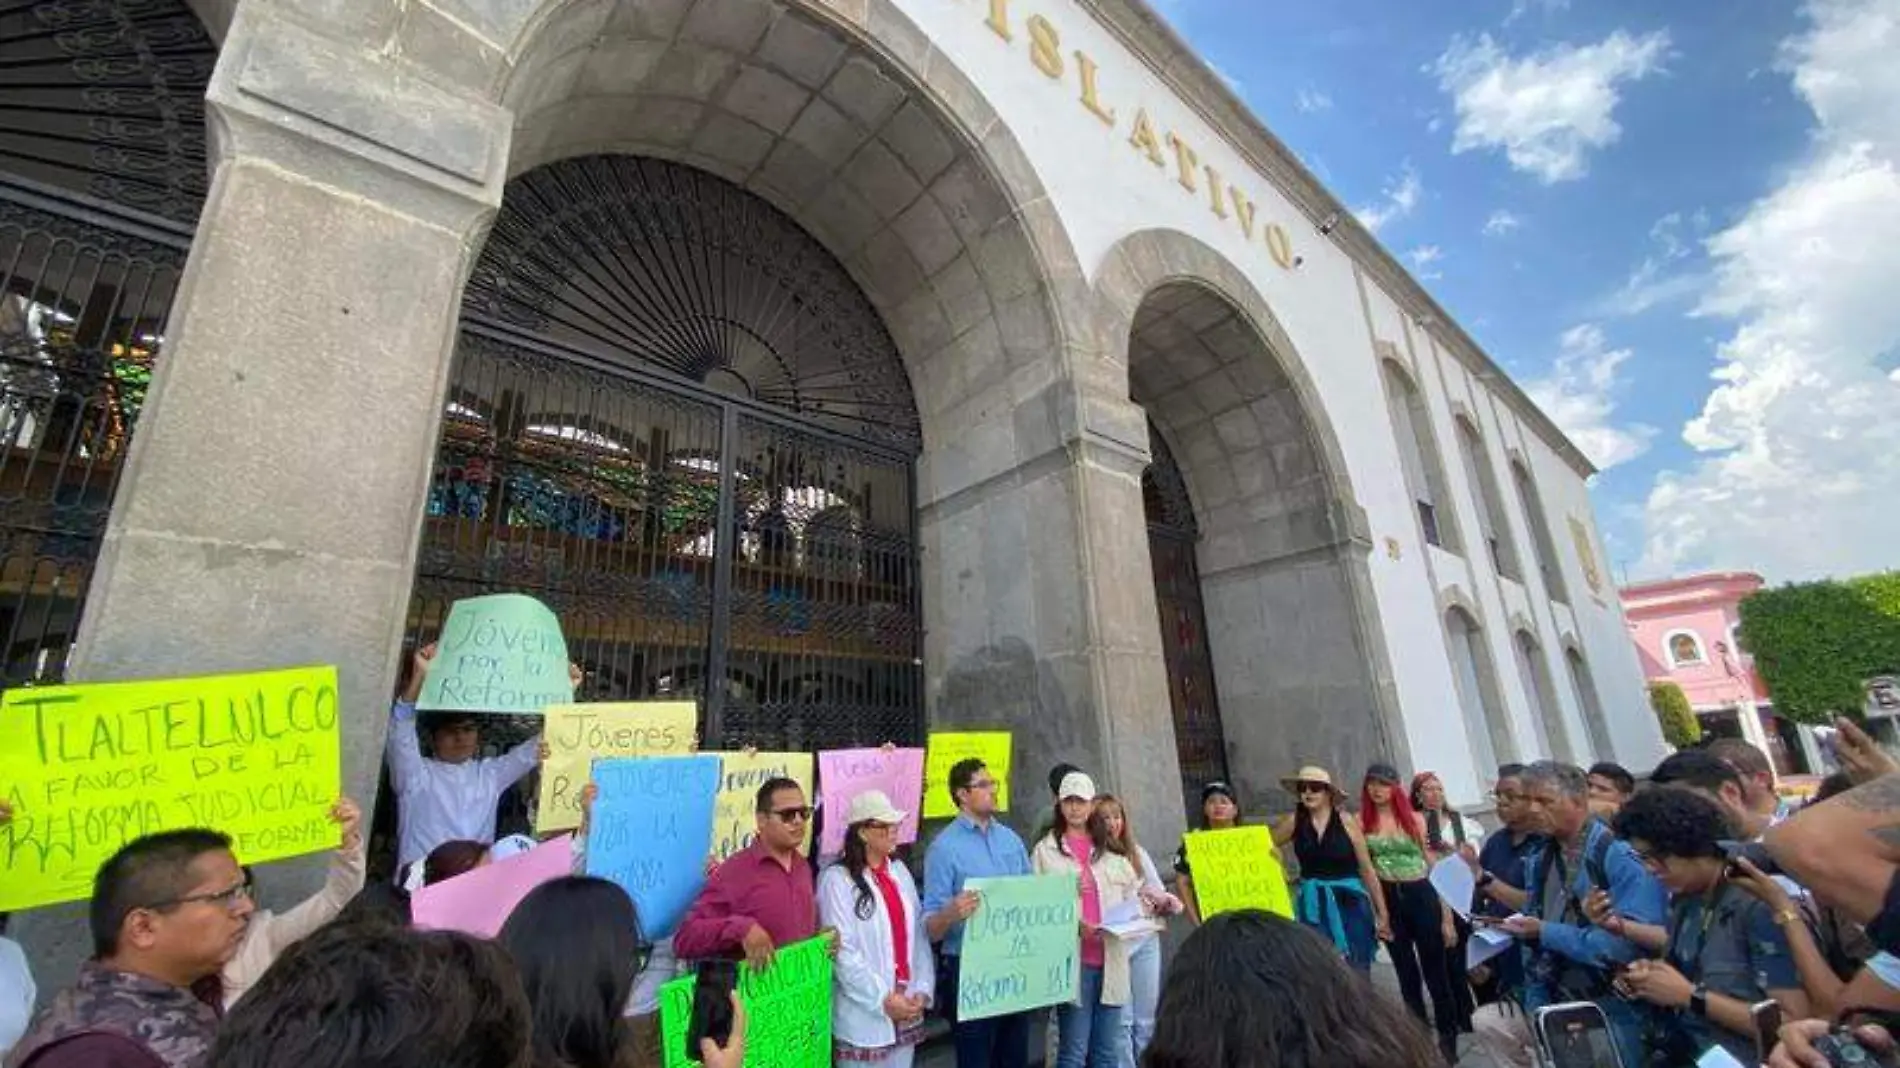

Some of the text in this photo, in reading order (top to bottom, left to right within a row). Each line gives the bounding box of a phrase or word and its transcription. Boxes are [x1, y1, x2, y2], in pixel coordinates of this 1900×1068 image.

[458, 654, 502, 675] por
[47, 764, 166, 804] FAVOR
[192, 754, 248, 779] DE
[274, 743, 314, 768] LA
